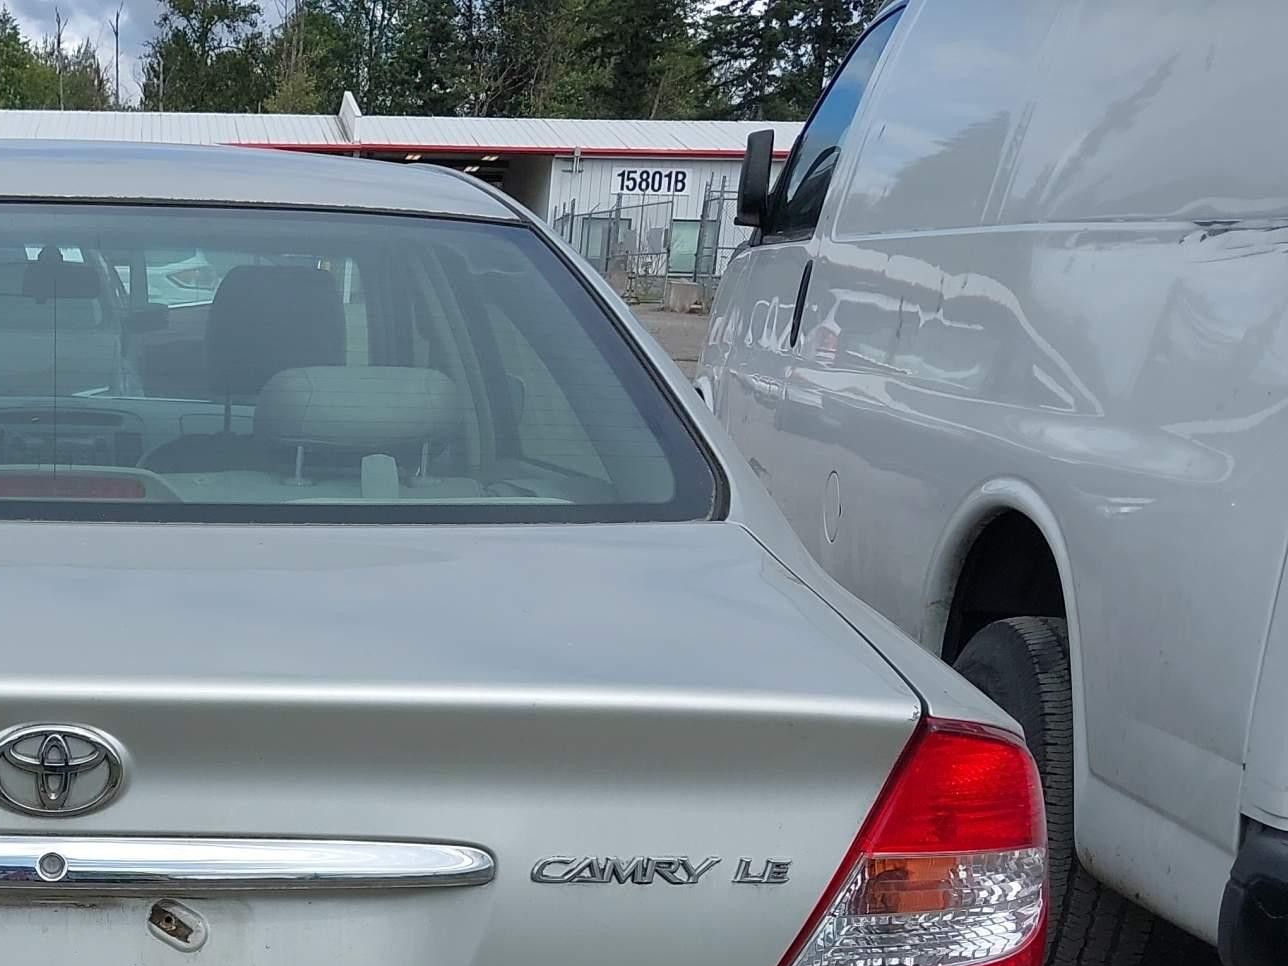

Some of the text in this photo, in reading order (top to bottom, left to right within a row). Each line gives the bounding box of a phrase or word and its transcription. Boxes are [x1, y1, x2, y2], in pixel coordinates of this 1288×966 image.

[617, 169, 687, 193] 15801B
[530, 856, 792, 884] CAMRY LE
